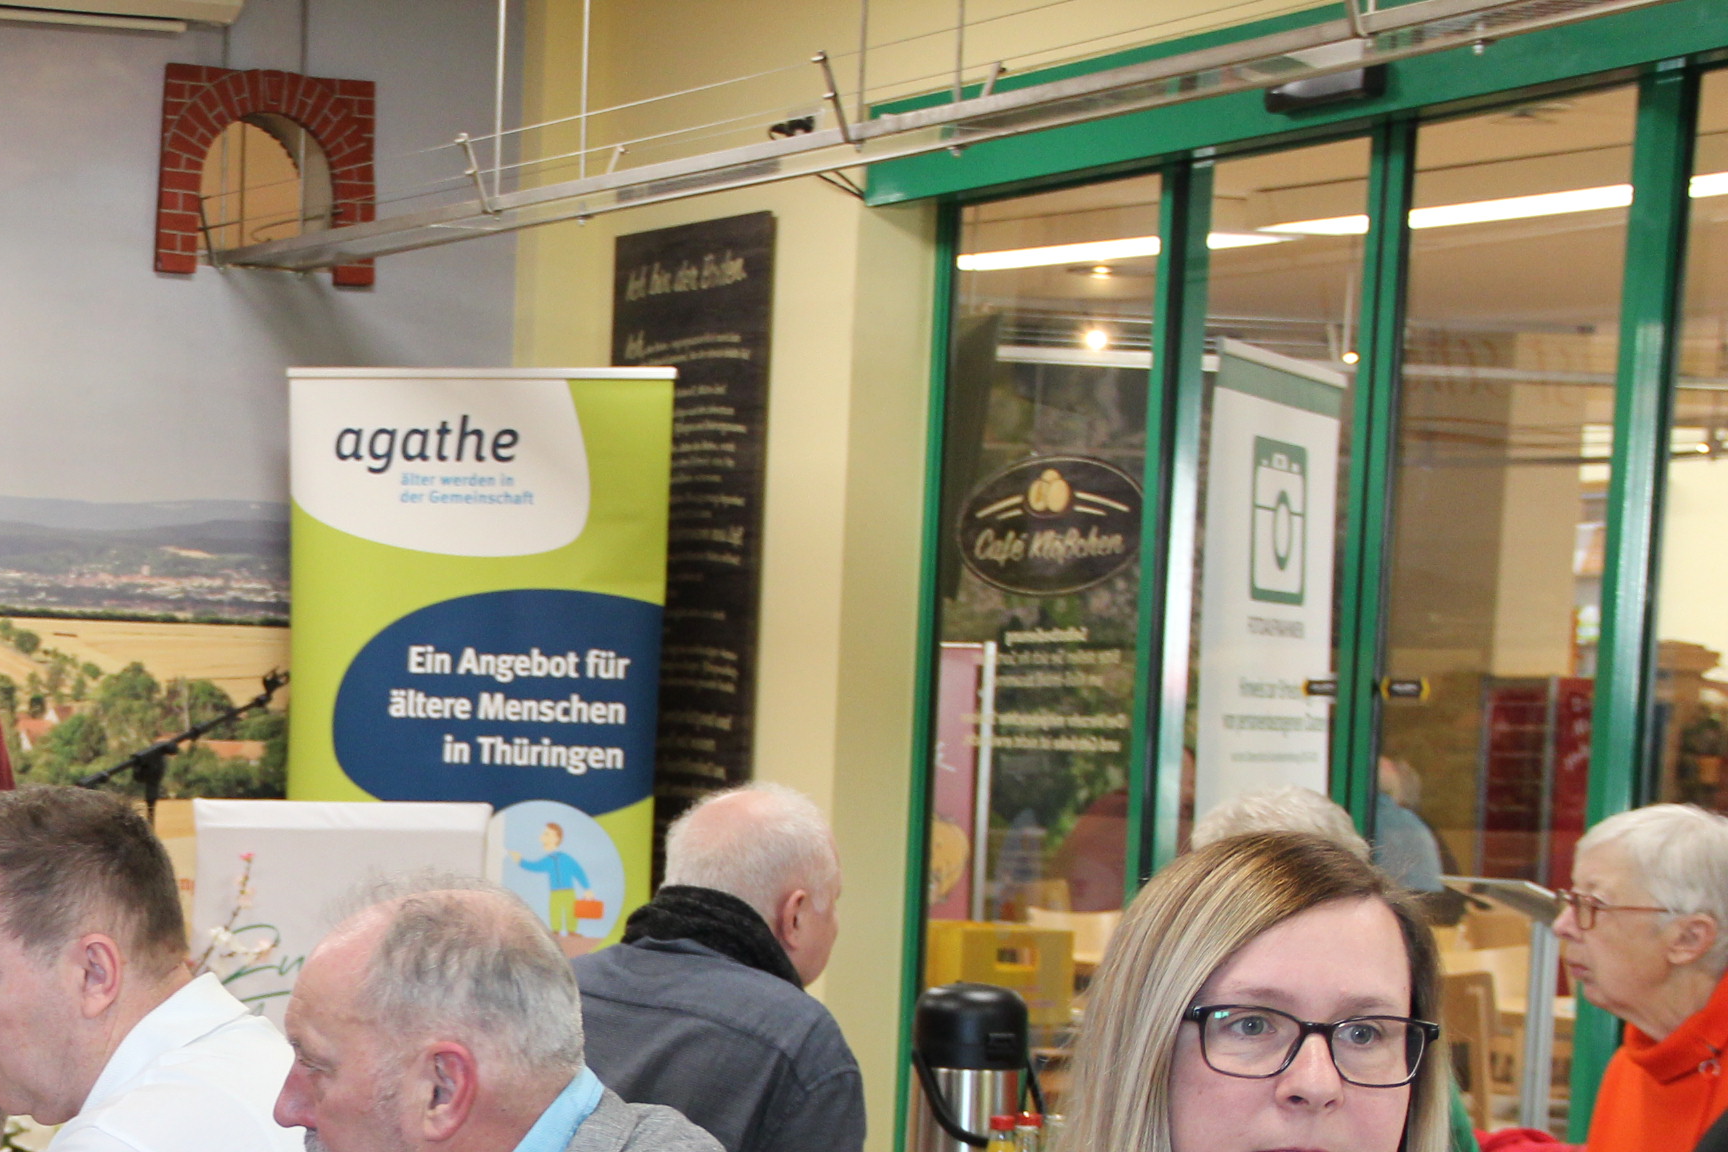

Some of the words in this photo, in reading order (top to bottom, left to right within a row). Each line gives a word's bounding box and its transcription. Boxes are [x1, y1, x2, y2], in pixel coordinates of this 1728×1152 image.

[334, 414, 520, 474] agathe
[400, 491, 423, 503] der
[429, 491, 534, 505] Gemeinschaft
[401, 473, 435, 486] älter
[440, 474, 496, 487] werden
[500, 474, 515, 487] in
[974, 528, 1028, 566] Café
[407, 645, 452, 675] Ein
[457, 646, 580, 684] Angebot
[585, 649, 631, 681] für
[388, 689, 472, 719] ältere
[477, 693, 626, 725] Menschen
[442, 735, 470, 764] in
[476, 736, 624, 775] Thüringen
